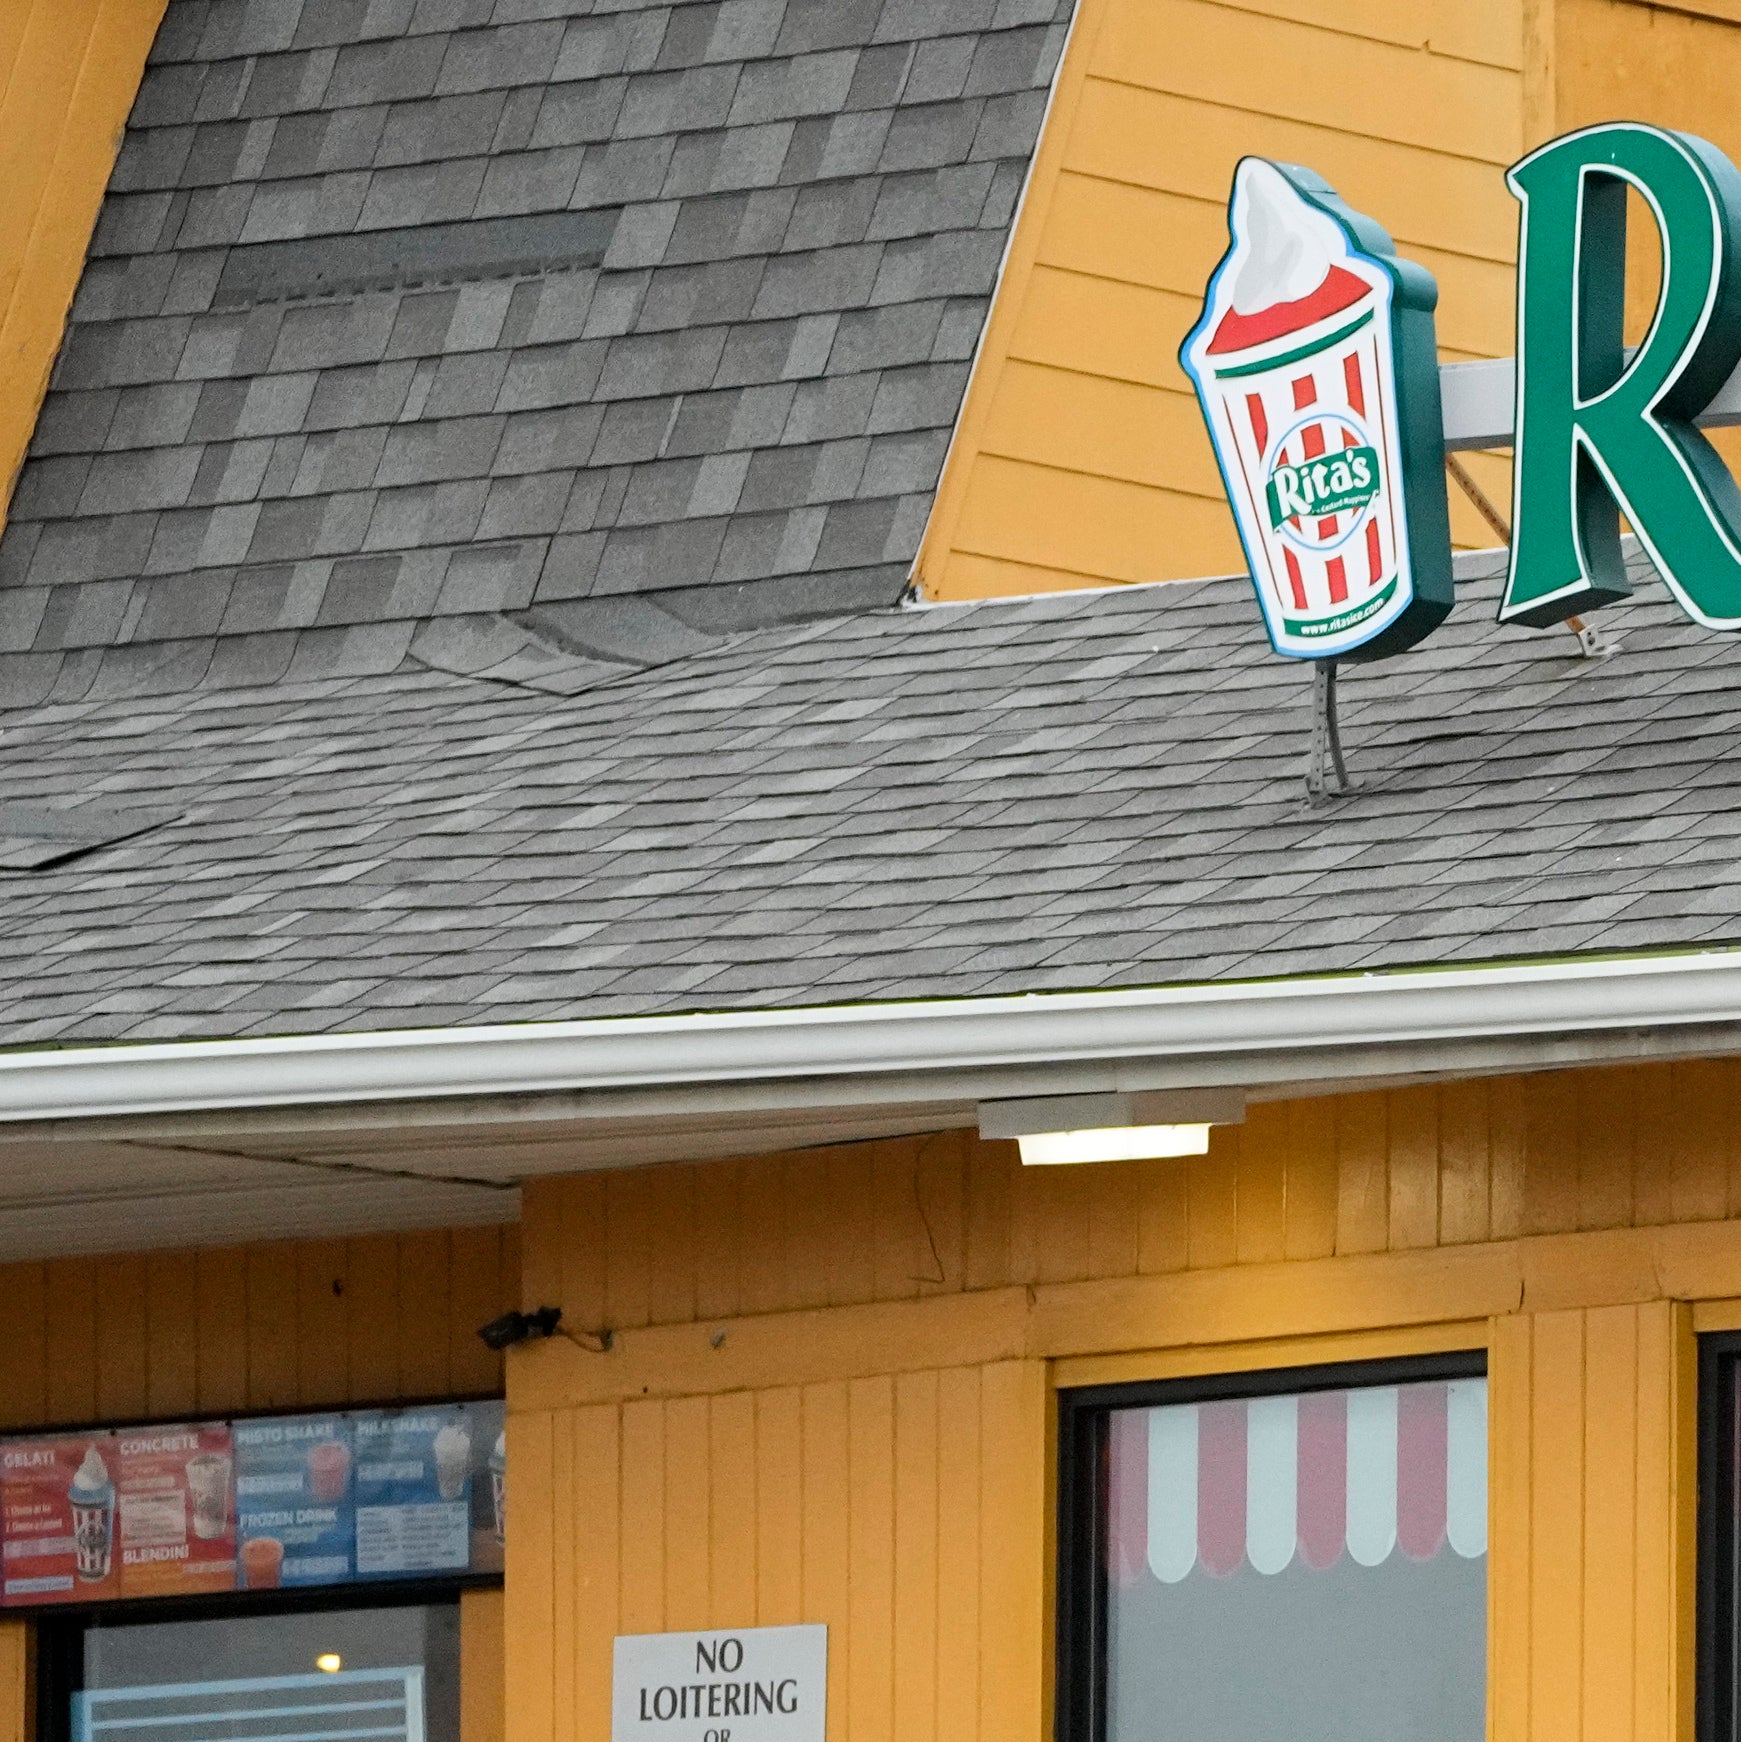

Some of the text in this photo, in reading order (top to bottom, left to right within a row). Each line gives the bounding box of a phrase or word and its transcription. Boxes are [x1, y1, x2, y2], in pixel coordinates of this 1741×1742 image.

[1273, 449, 1373, 521] Rita's
[1300, 597, 1384, 634] www.ritasice.com
[120, 1434, 199, 1455] CONCRETE
[4, 1451, 55, 1469] GELATI
[240, 1508, 337, 1528] FROZEN DRINK
[122, 1544, 190, 1566] BLENDINI
[696, 1638, 744, 1674] NO
[640, 1679, 798, 1721] LOITERING
